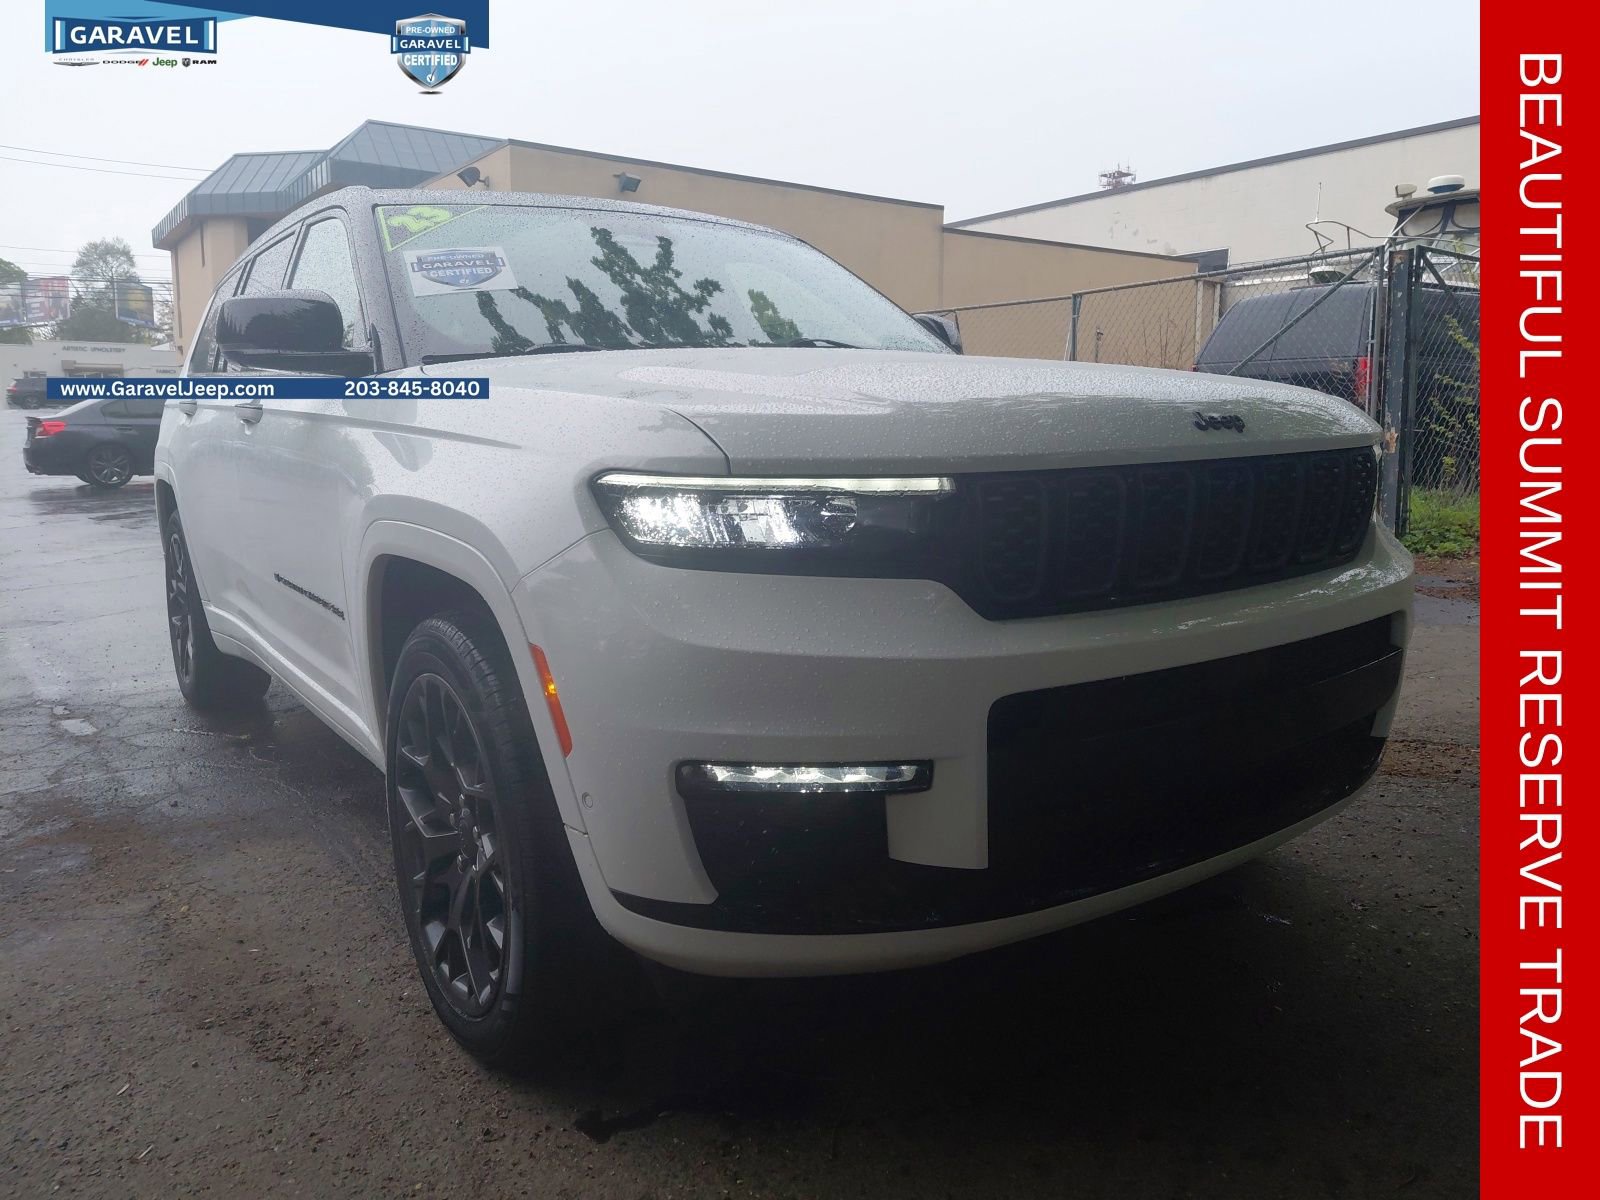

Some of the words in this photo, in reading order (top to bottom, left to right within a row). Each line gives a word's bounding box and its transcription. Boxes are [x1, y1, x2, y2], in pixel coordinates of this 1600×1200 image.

[422, 260, 495, 269] GARAVEL
[430, 267, 493, 277] CERTIFIED
[1193, 411, 1246, 433] Jeep
